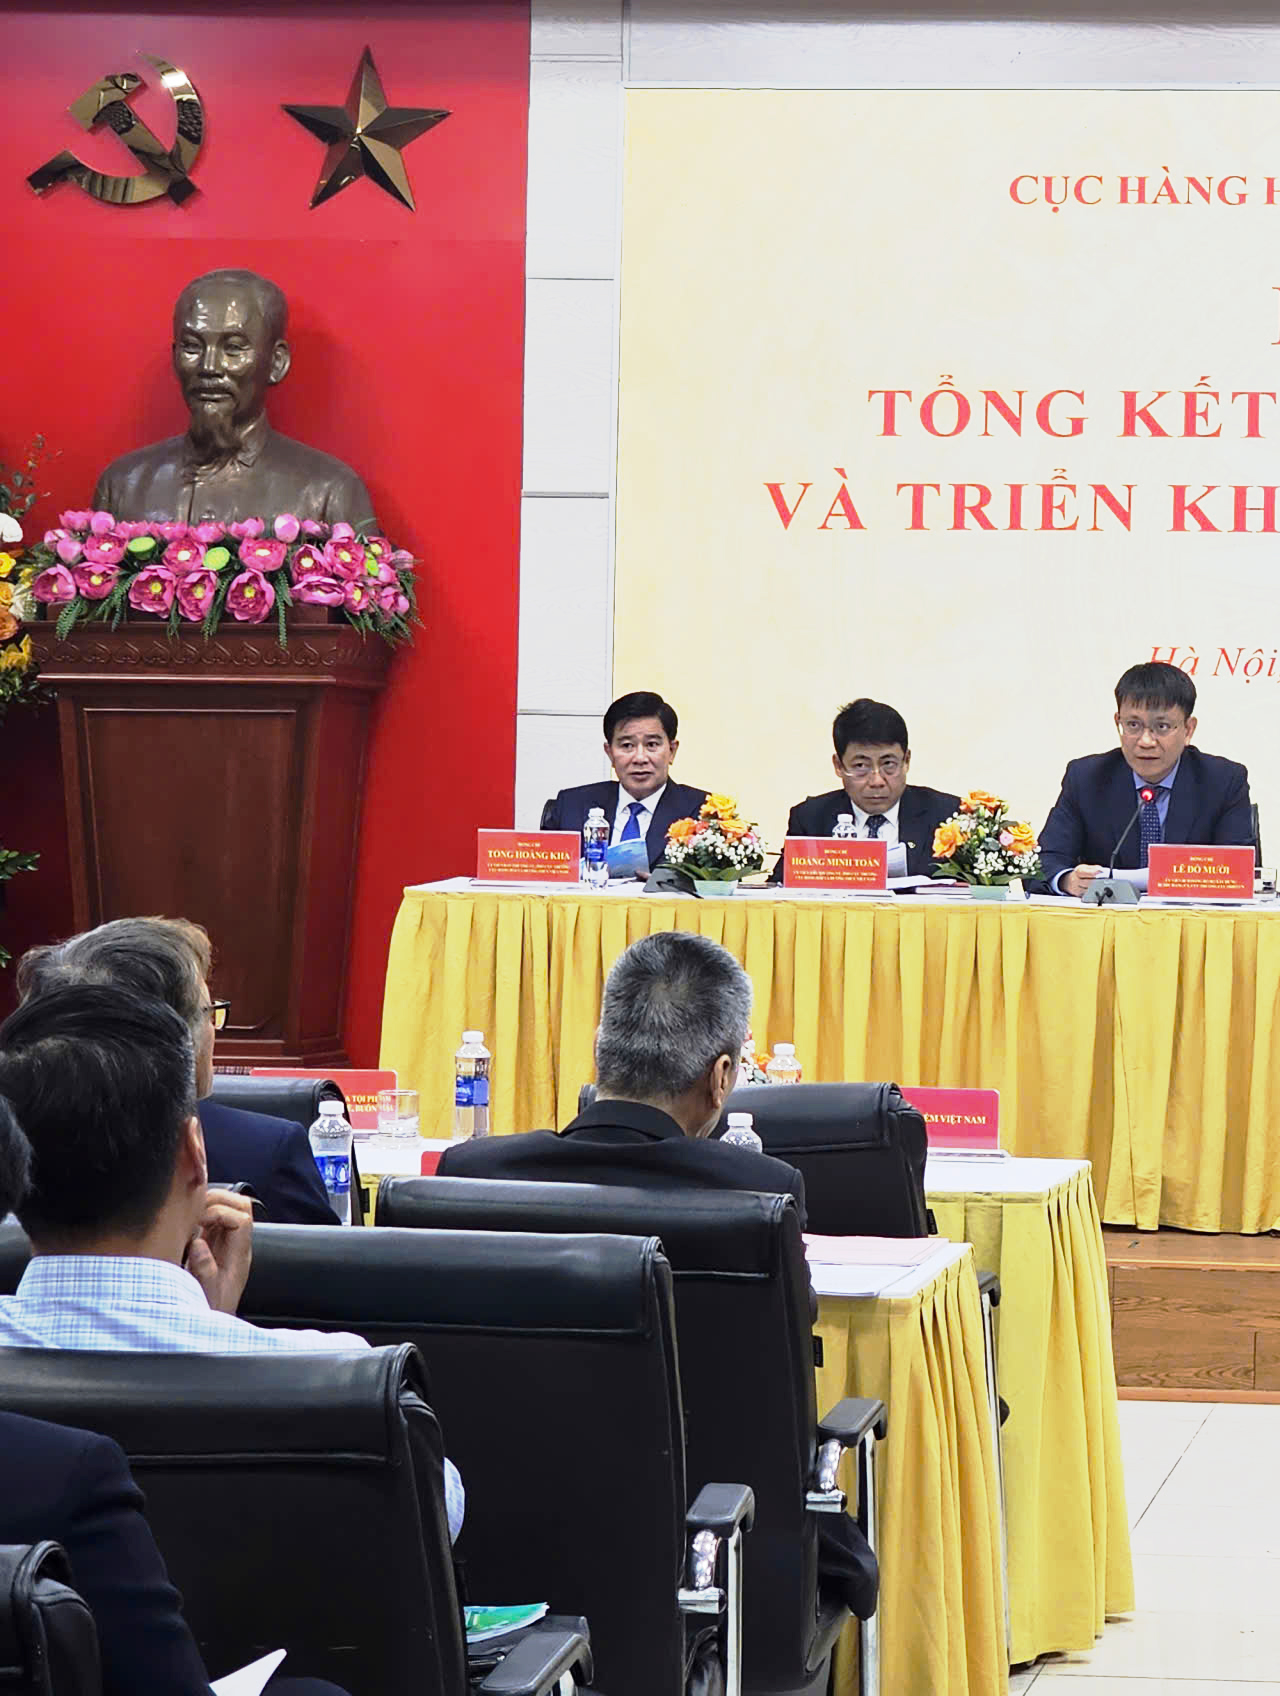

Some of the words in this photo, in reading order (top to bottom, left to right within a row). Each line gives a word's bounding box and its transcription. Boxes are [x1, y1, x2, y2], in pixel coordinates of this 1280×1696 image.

[1009, 175, 1103, 215] CỤC
[1117, 167, 1248, 206] HÀNG
[867, 373, 1088, 437] TỔNG
[1119, 374, 1277, 438] KẾT
[763, 467, 867, 529] VÀ
[895, 464, 1138, 532] TRIỂN
[826, 858, 852, 867] MINH
[1173, 863, 1186, 873] LÊ
[940, 1114, 962, 1125] VIỆT
[963, 1115, 986, 1125] NAM
